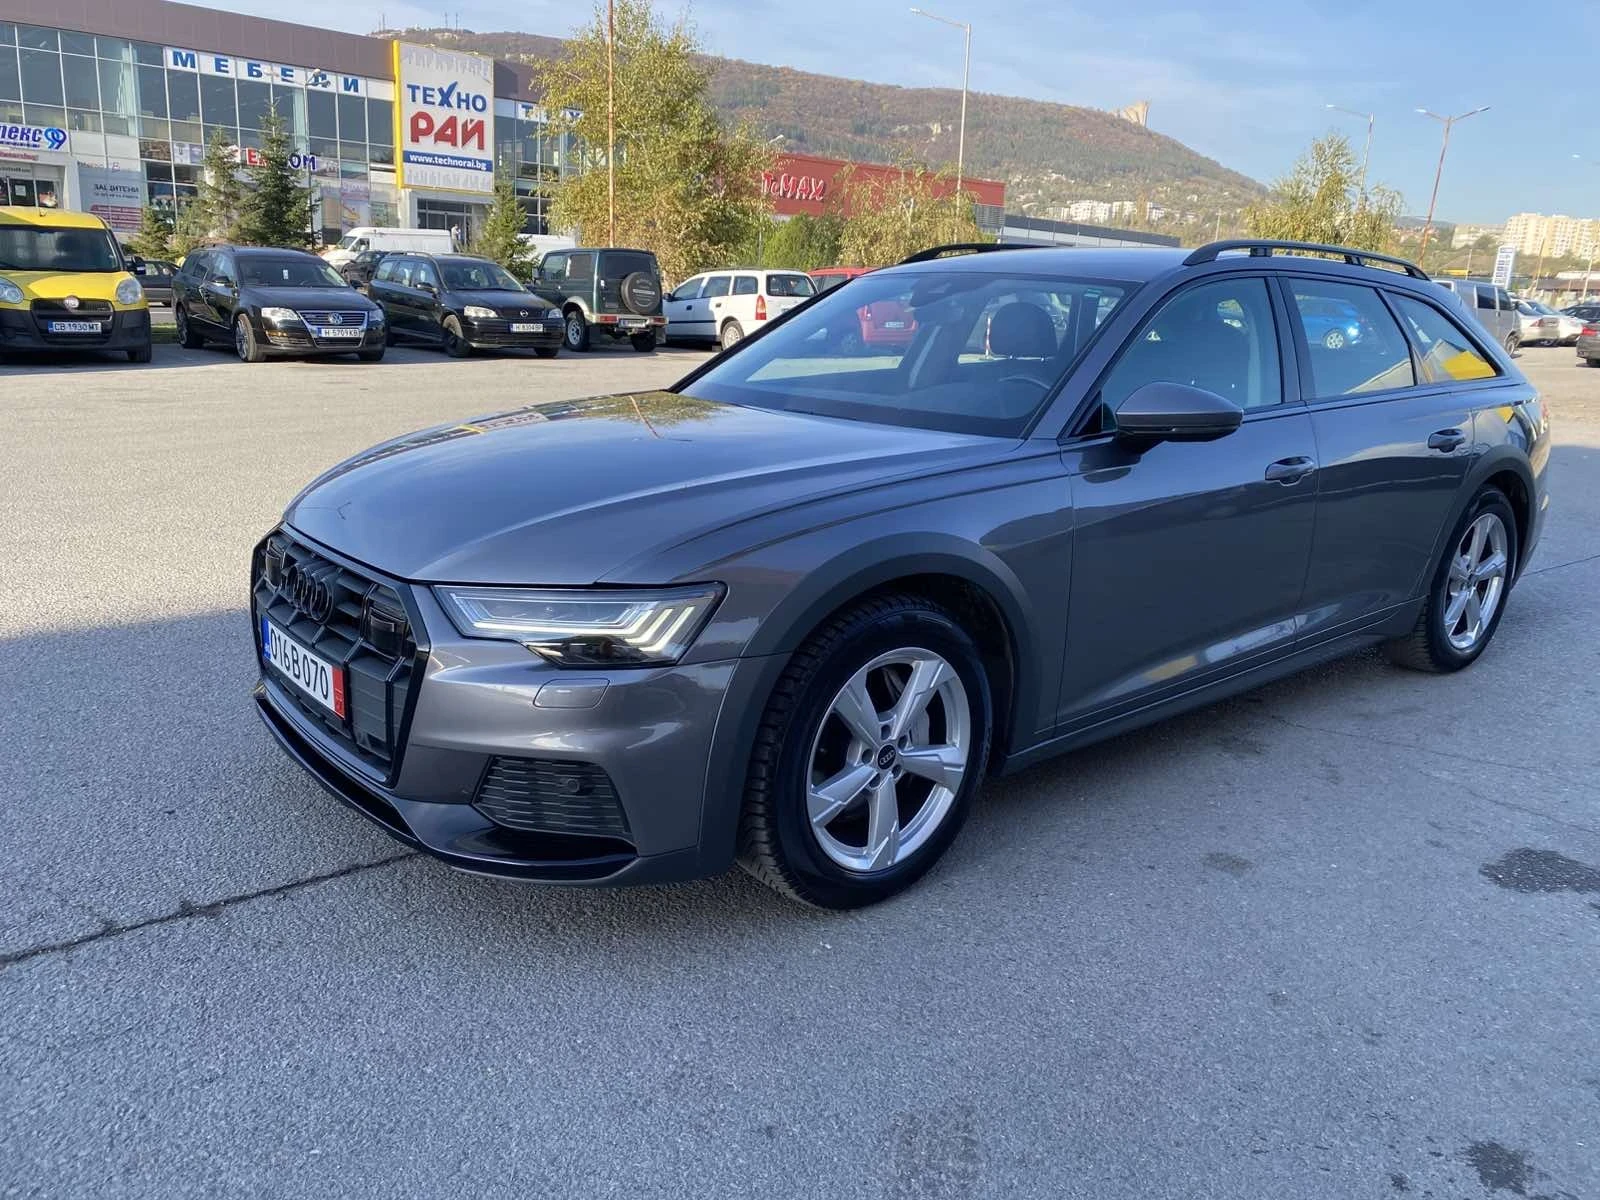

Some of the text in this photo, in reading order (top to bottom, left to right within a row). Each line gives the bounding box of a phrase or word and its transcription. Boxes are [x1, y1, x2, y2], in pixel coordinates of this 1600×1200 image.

[407, 81, 487, 112] ТЕХНО
[410, 111, 485, 150] РАЙ
[409, 154, 487, 171] www.technorai.bg
